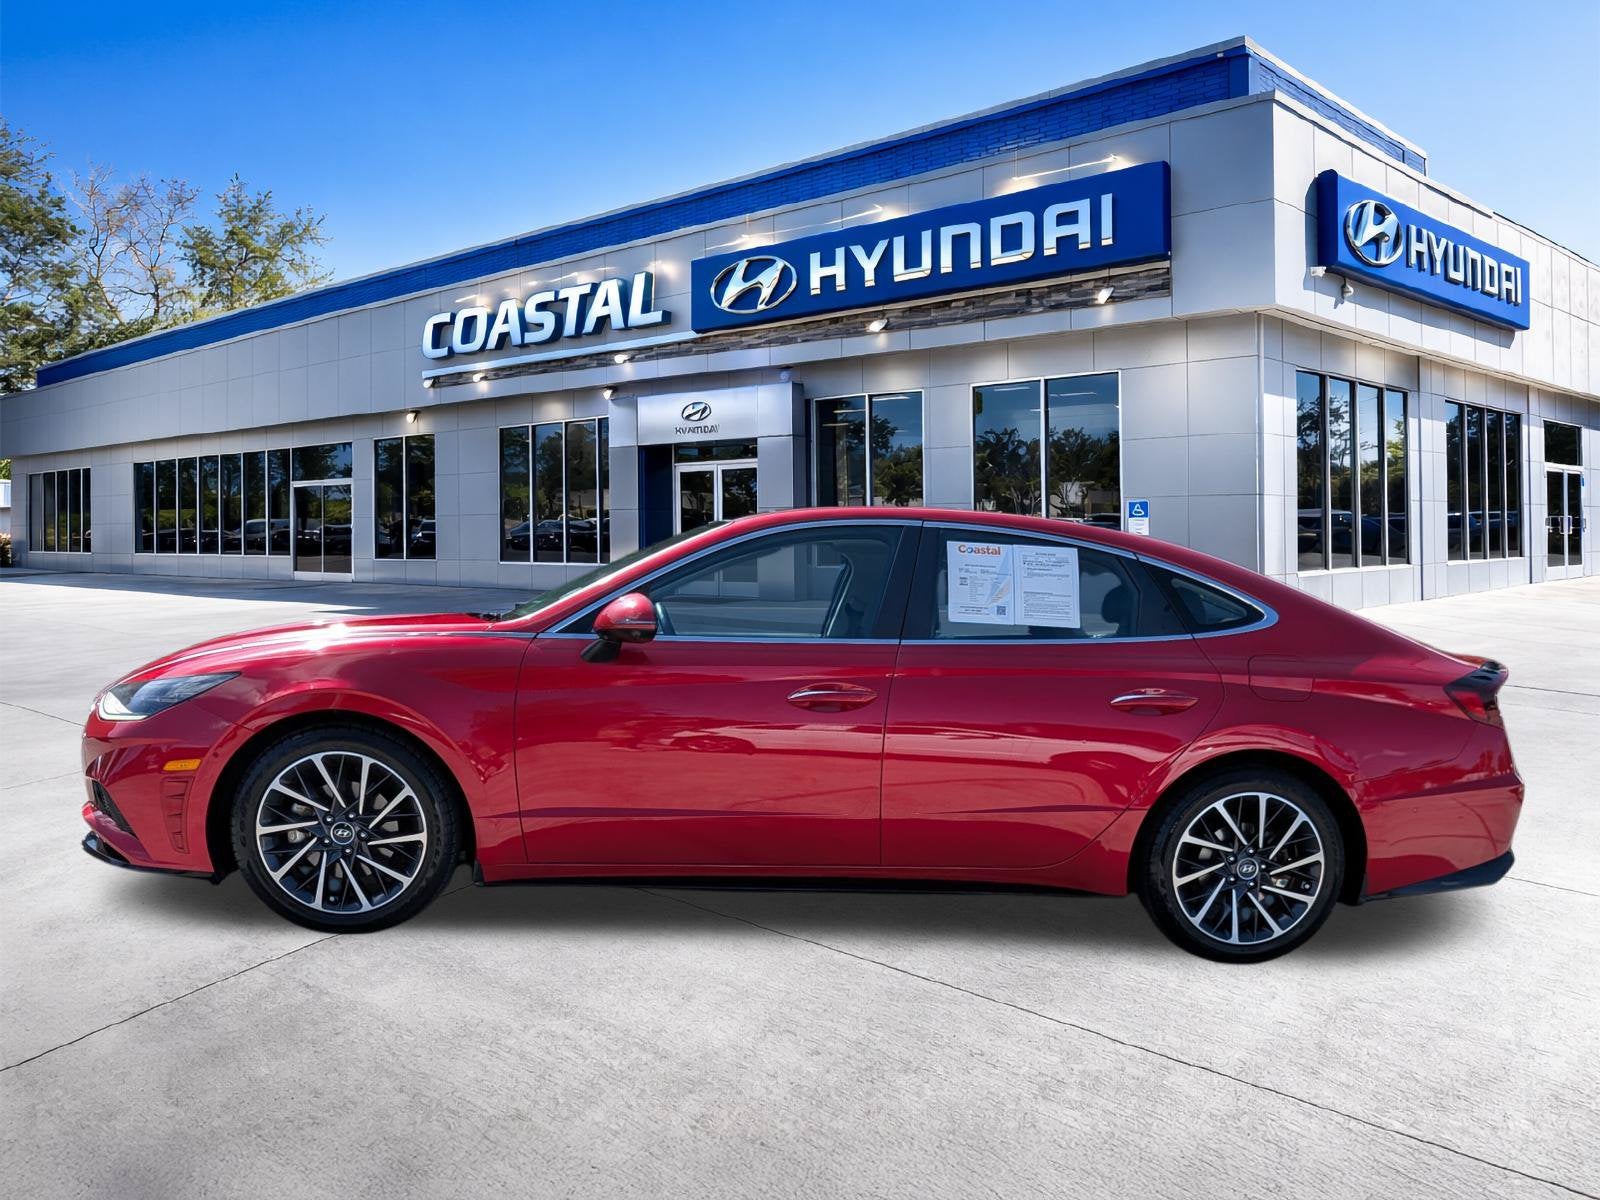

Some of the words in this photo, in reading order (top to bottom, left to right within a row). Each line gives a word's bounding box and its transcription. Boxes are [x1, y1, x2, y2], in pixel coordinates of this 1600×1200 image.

[809, 193, 1113, 296] HYUNDAI
[1406, 224, 1522, 306] HYUNDAI
[422, 271, 667, 359] COASTAL
[958, 544, 1001, 556] Coastal
